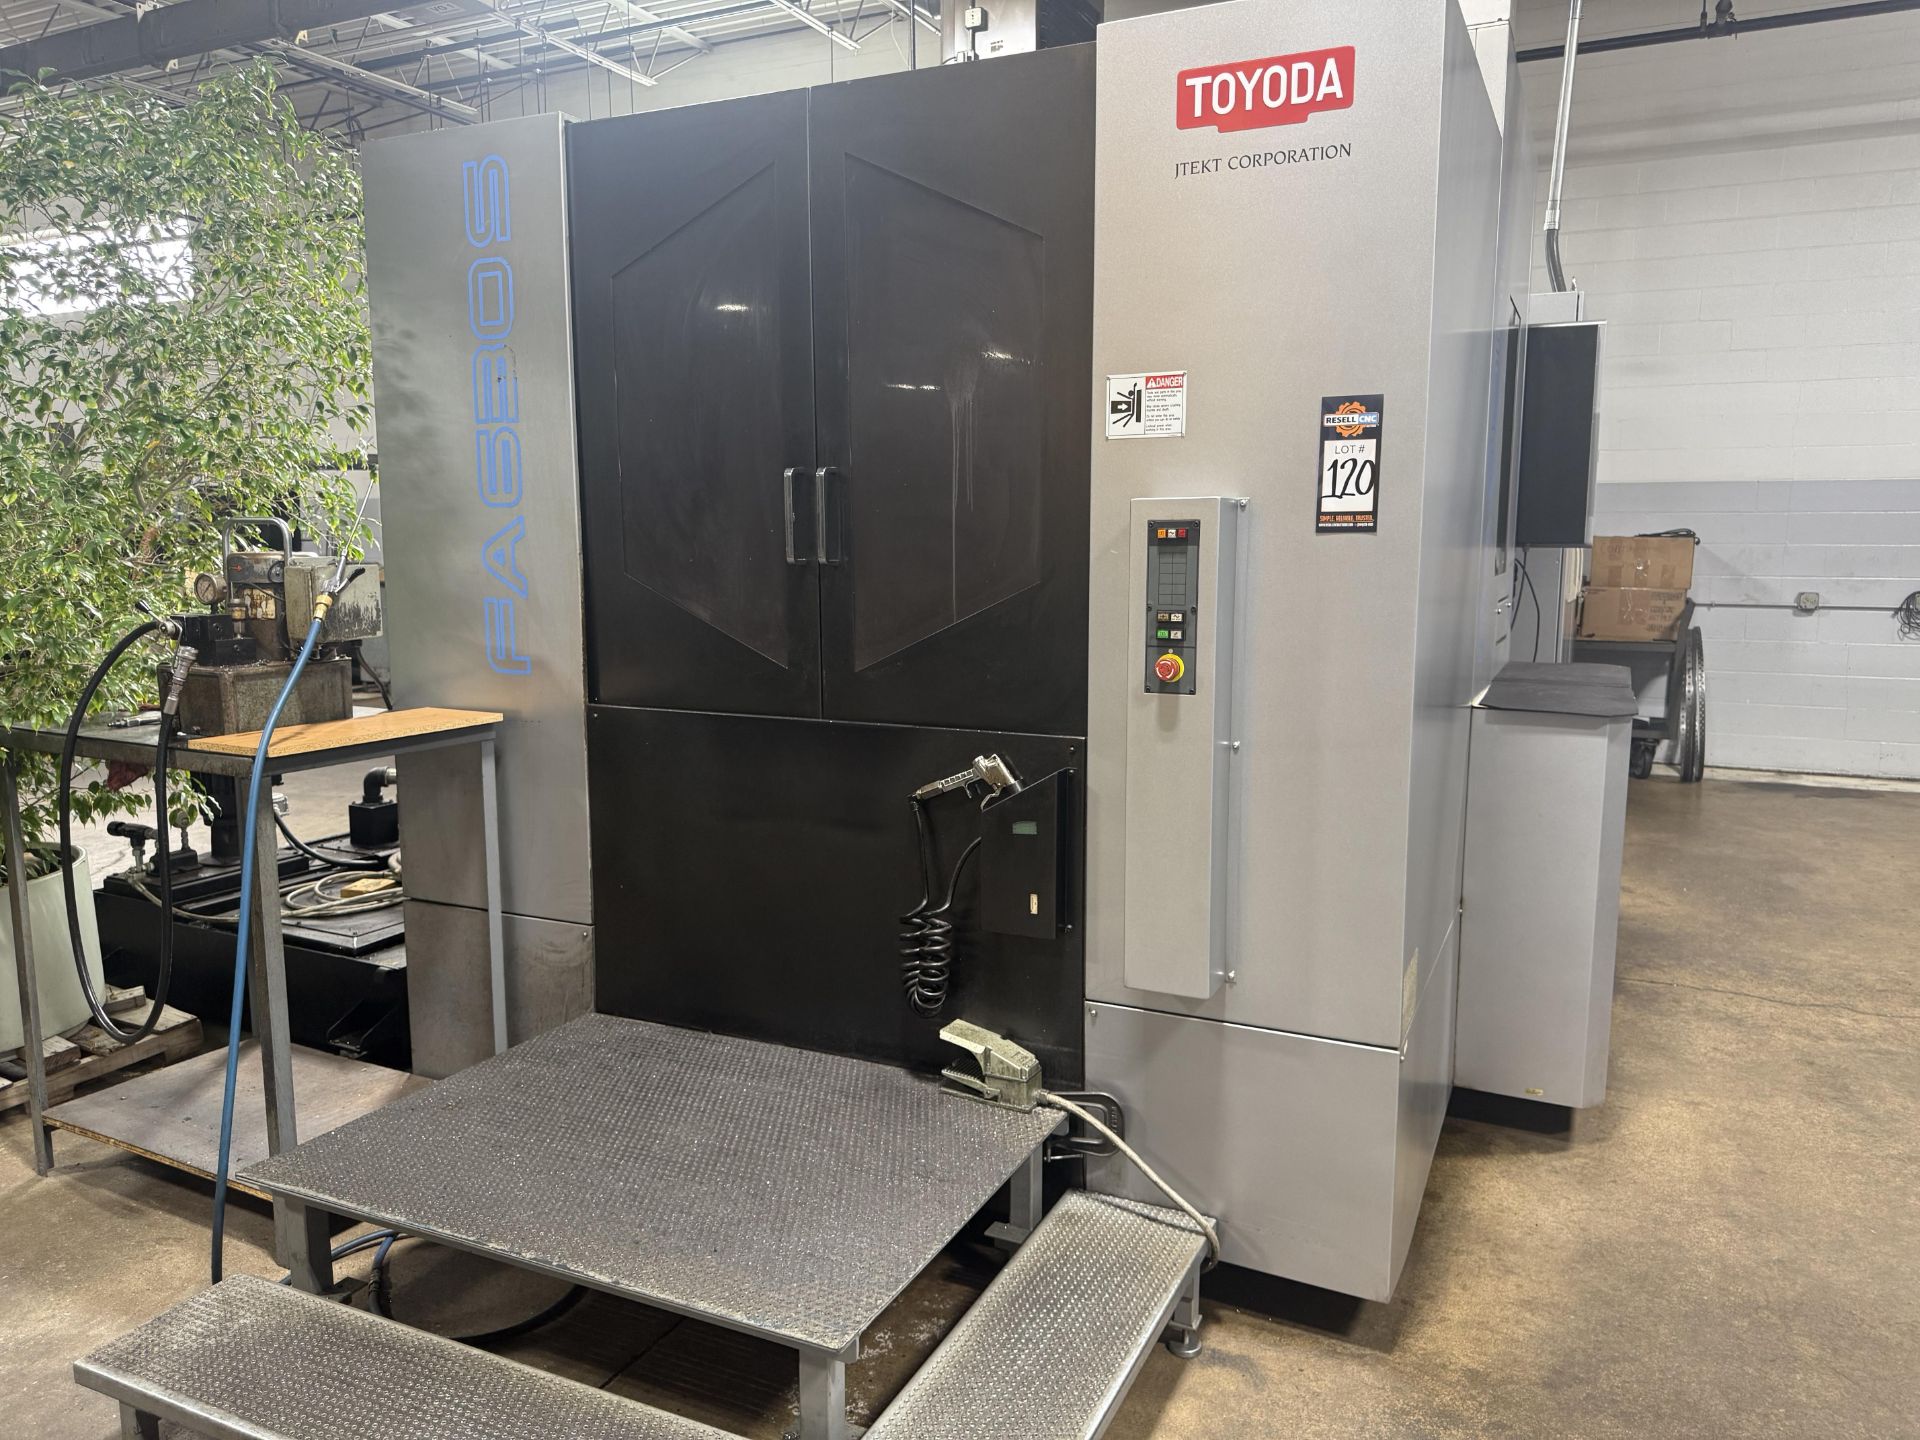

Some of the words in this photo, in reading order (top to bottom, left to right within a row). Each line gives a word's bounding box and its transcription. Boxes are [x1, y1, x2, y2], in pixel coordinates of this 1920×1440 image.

[1185, 57, 1344, 118] TOYODA
[1174, 158, 1222, 179] JTEKT
[1227, 143, 1352, 171] CORPORATION
[1156, 376, 1184, 389] DANGER
[1325, 416, 1356, 424] RESELL
[1358, 414, 1377, 423] CNC
[1335, 445, 1356, 455] LOT
[1358, 444, 1366, 454] #
[1320, 457, 1375, 499] 120
